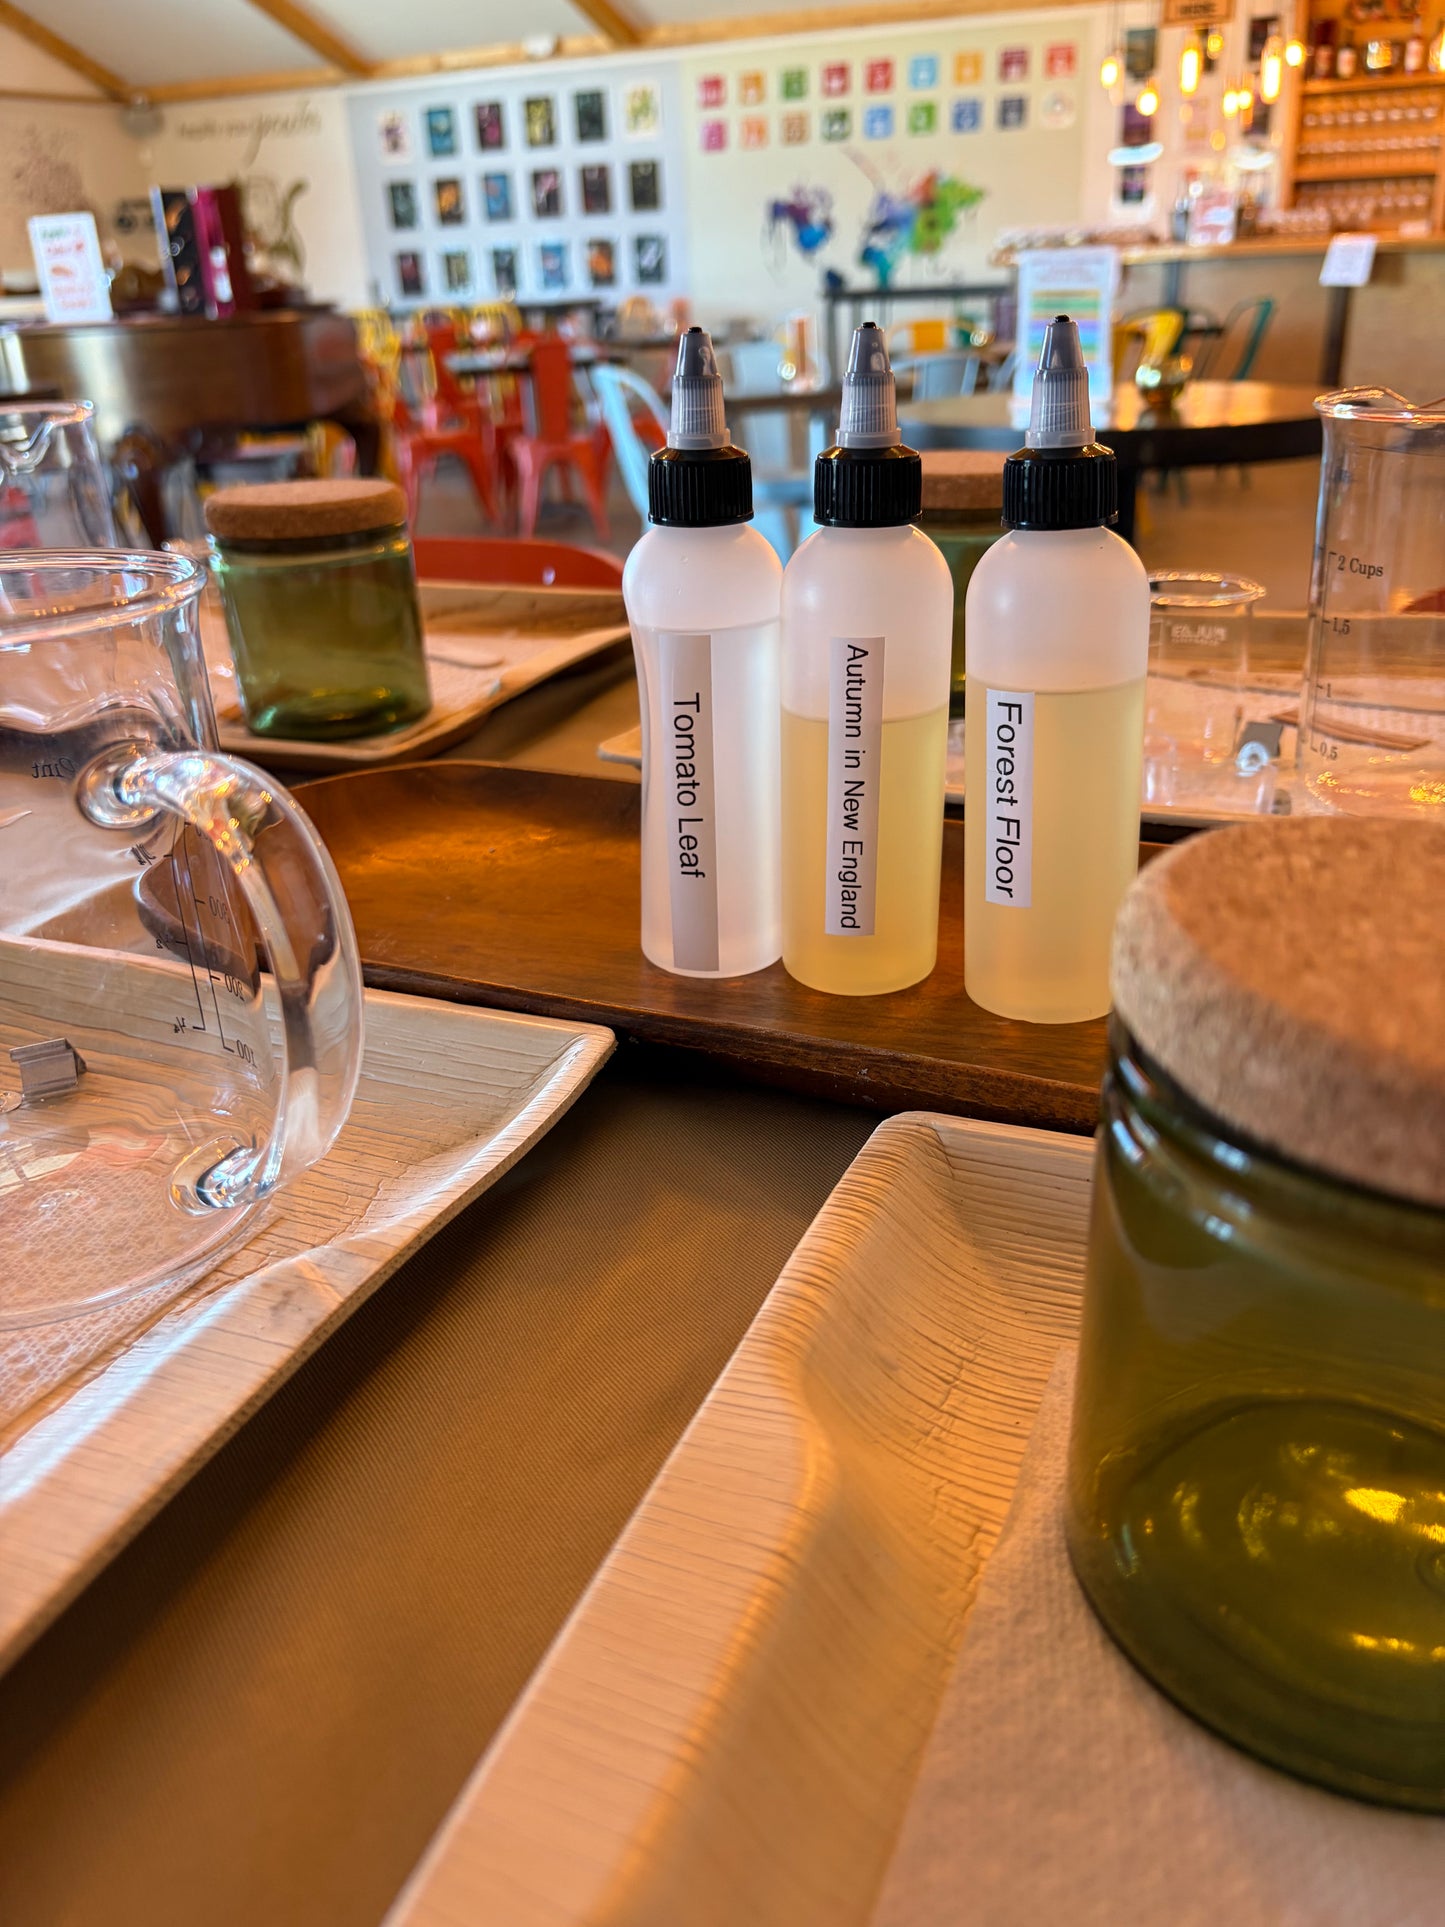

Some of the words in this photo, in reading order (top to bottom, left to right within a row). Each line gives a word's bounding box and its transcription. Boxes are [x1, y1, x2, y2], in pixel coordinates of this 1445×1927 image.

[1337, 555, 1346, 571] 2
[1349, 558, 1384, 579] Cups
[845, 644, 869, 738] Autumn
[1327, 683, 1332, 698] 1
[673, 692, 701, 807] Tomato
[844, 749, 866, 769] in
[996, 702, 1022, 806] Forest
[843, 780, 865, 831] New
[678, 818, 706, 878] Leaf
[995, 816, 1021, 898] Floor
[838, 840, 864, 929] England
